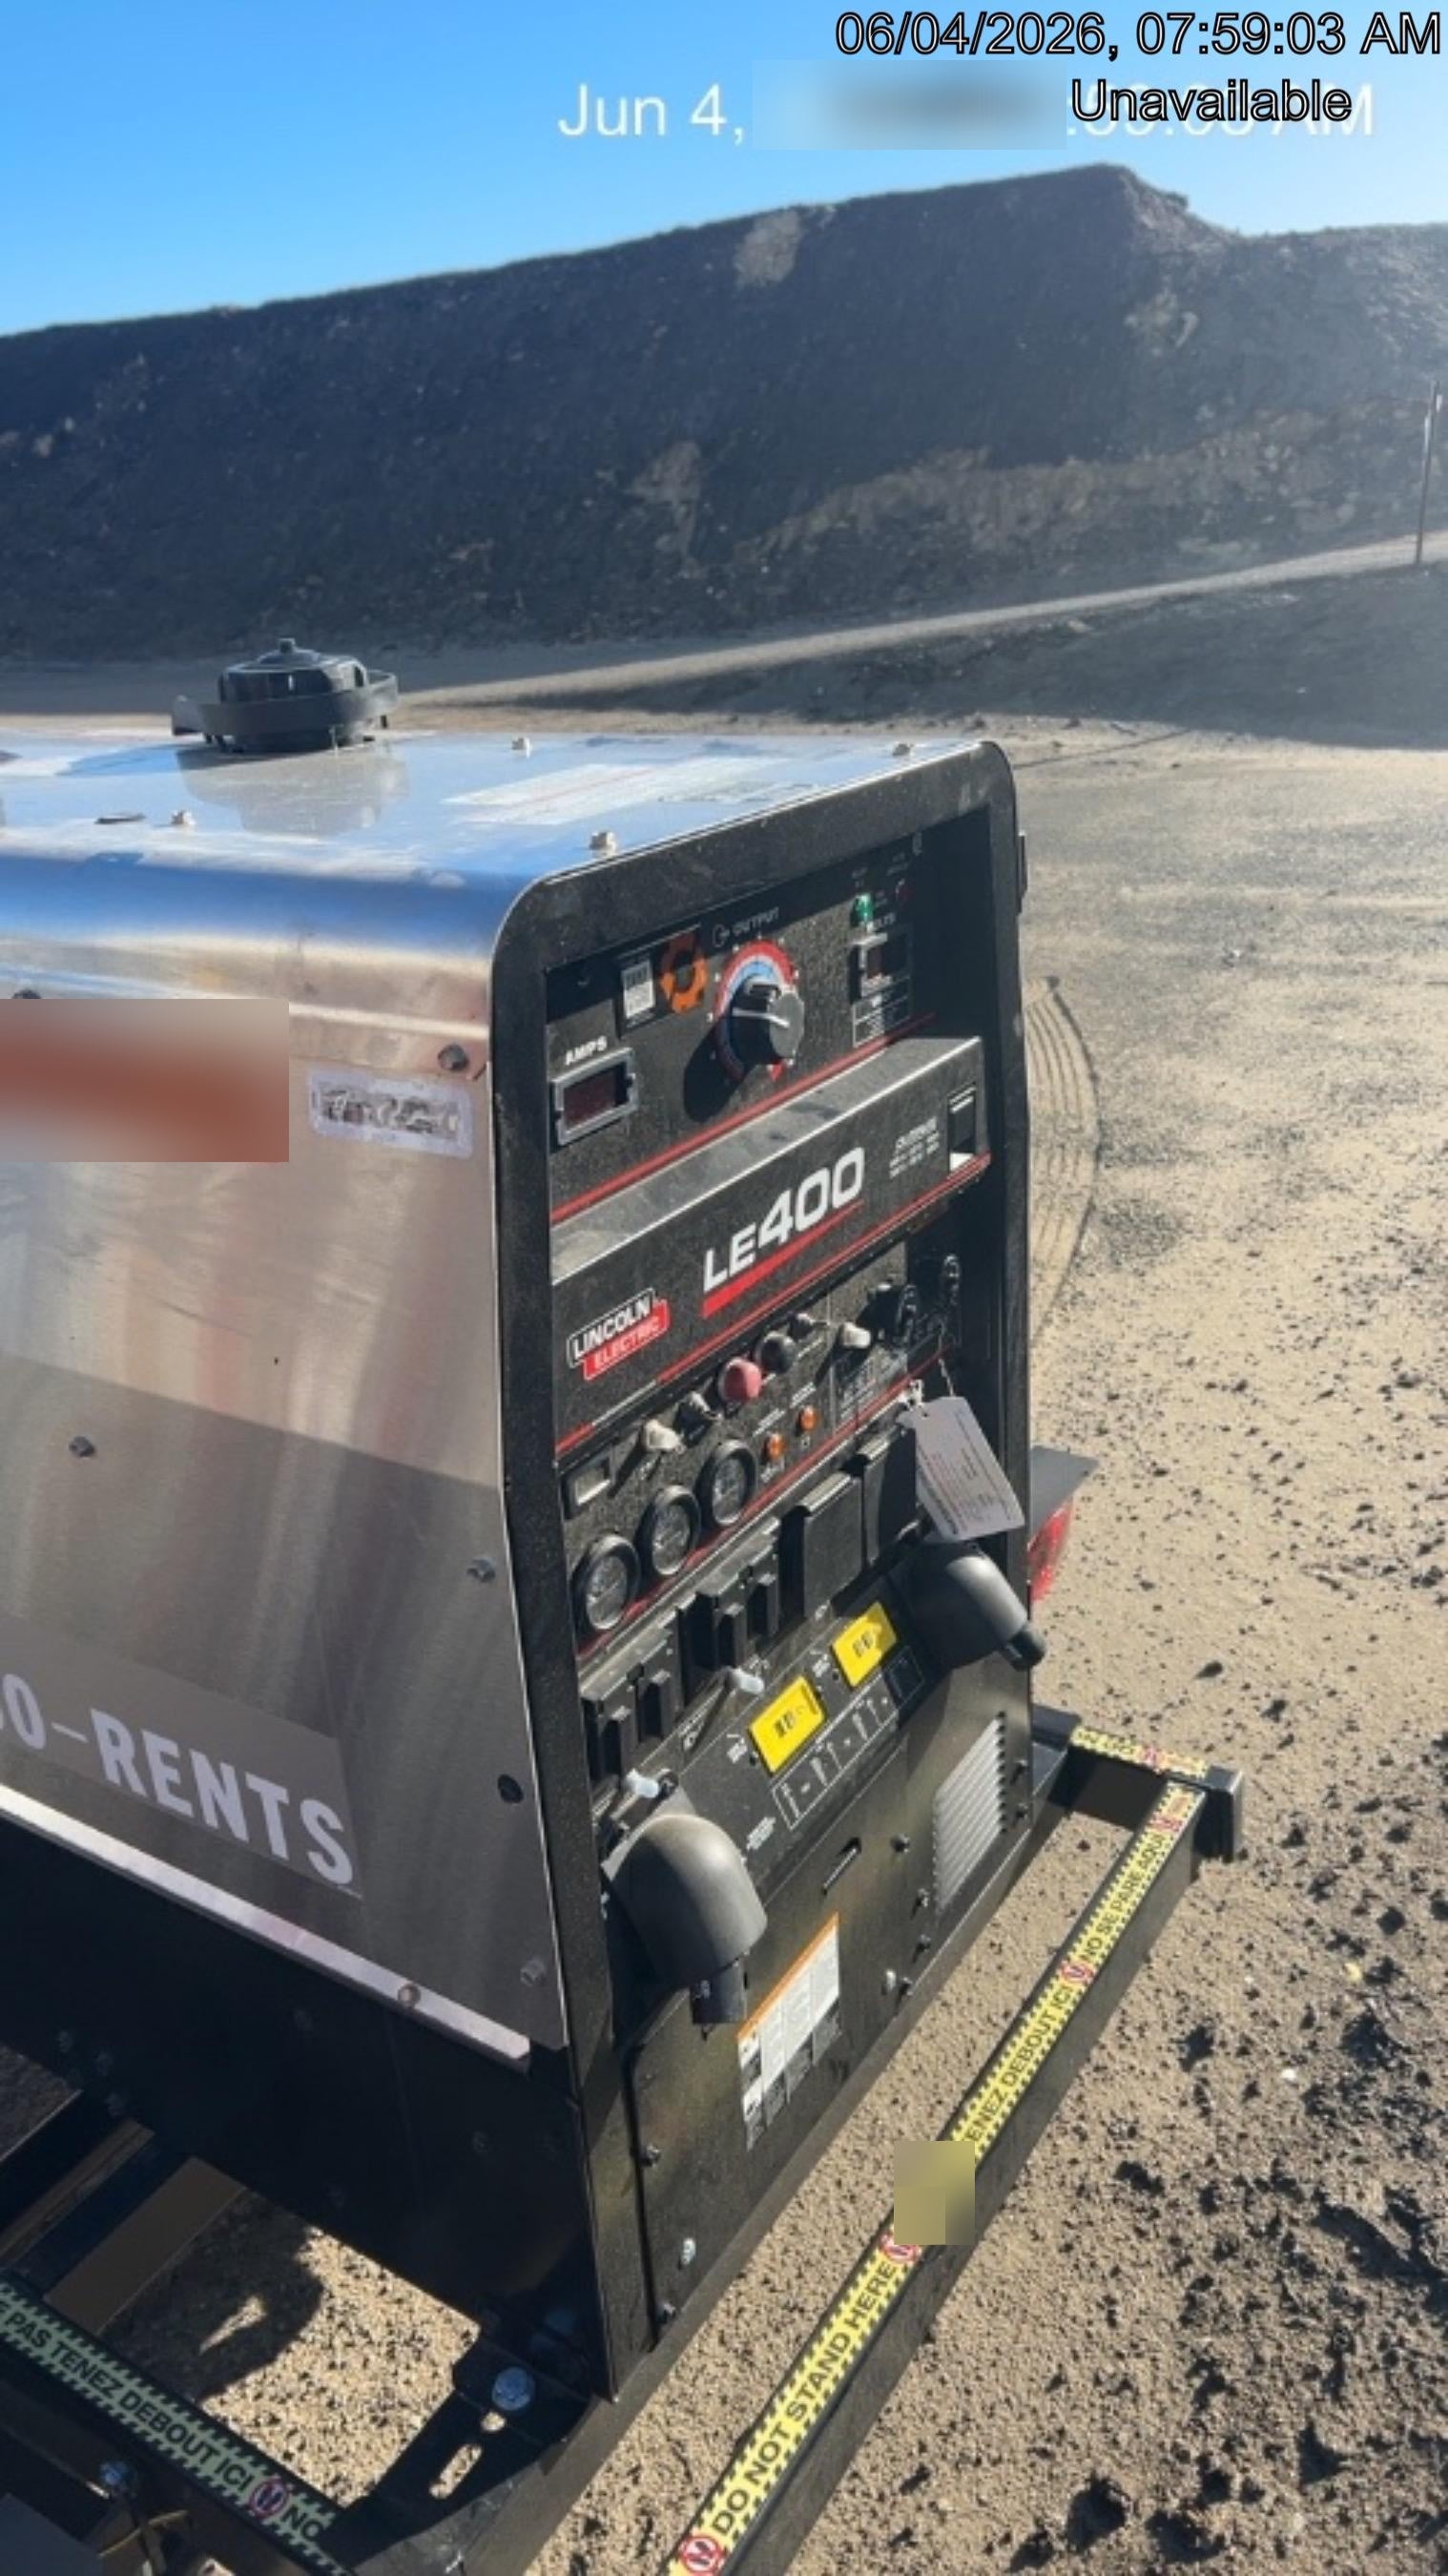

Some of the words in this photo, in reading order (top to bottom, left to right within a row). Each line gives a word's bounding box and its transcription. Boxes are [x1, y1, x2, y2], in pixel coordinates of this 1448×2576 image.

[565, 1035, 608, 1067] AMPS
[703, 1146, 865, 1294] LE400
[573, 1295, 652, 1360] LINCOLN
[594, 1312, 663, 1372] ELECTRIC
[0, 1672, 354, 1886] 0-RENTS
[1079, 1941, 1104, 1963] NO
[962, 2088, 1009, 2142] ENEZ
[1002, 2009, 1064, 2088] DEBOUT
[1050, 1984, 1075, 2013] ICI
[5, 2312, 52, 2348] PAS
[52, 2341, 123, 2399] TENEZ
[119, 2389, 219, 2467] DEBOUT
[216, 2463, 256, 2493] ICI
[712, 2488, 750, 2537] DO
[745, 2424, 796, 2488] NOT
[786, 2333, 853, 2424] STAND
[849, 2264, 897, 2329] HERE
